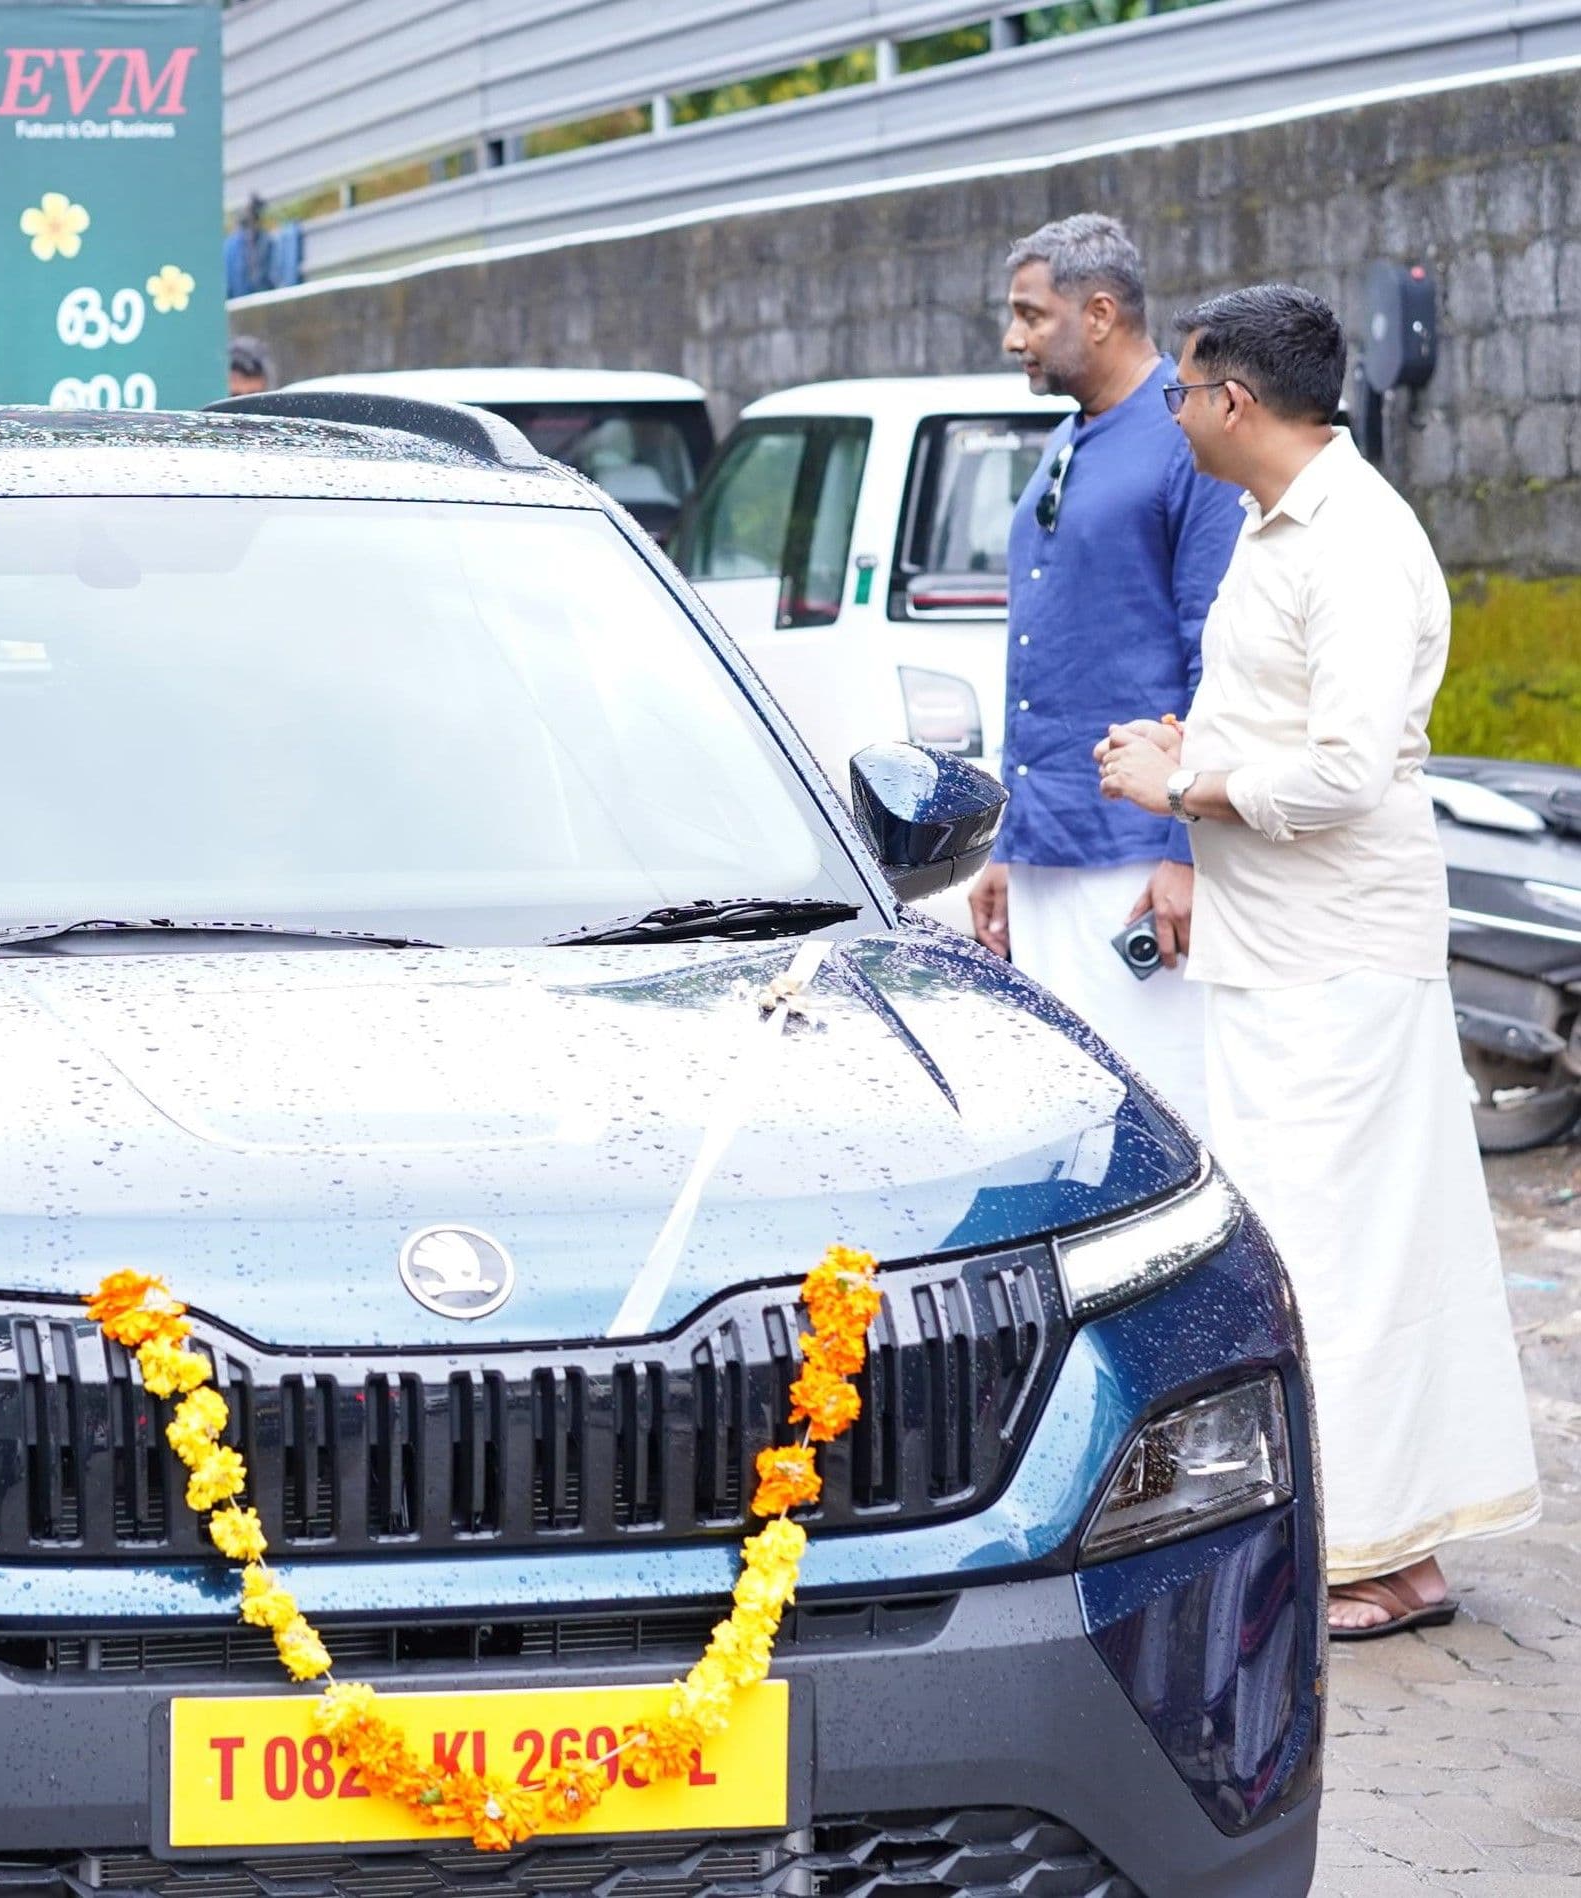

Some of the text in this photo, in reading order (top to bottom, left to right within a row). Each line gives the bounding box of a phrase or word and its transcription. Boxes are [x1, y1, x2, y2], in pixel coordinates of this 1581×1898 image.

[15, 120, 175, 139] Future is Our Business
[210, 1737, 245, 1801] T
